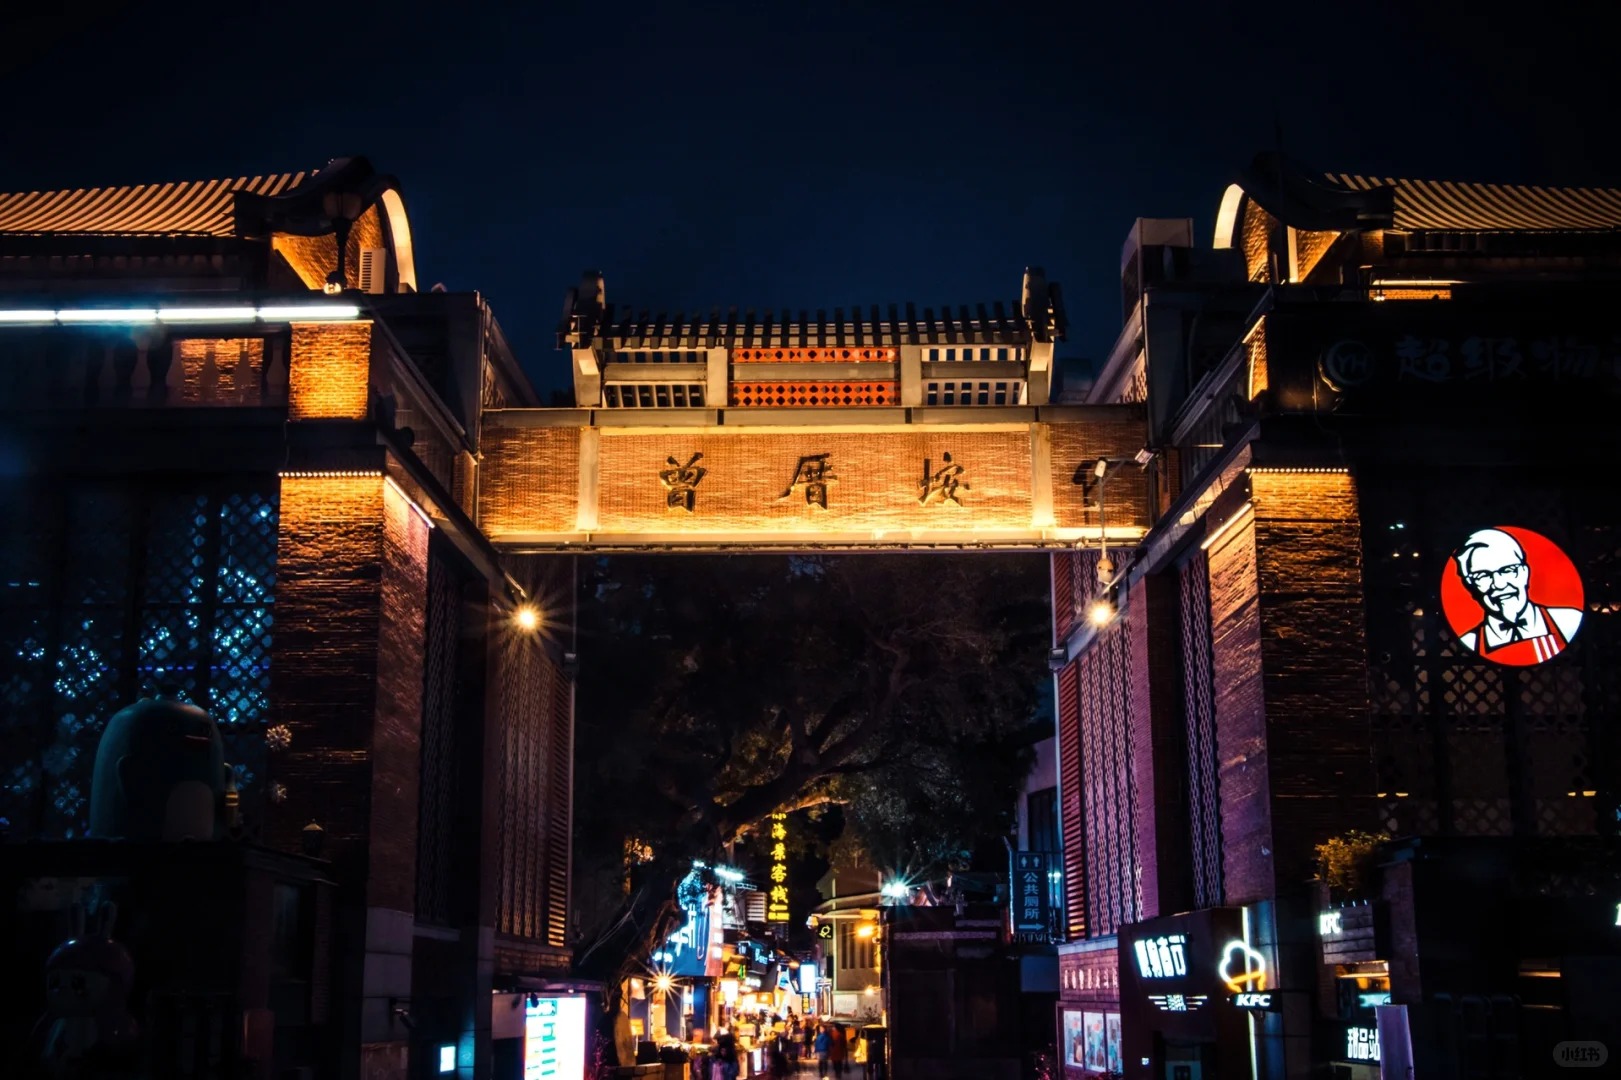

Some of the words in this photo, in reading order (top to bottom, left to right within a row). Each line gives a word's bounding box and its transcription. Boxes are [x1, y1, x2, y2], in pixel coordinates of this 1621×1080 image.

[659, 451, 970, 512] 曾厝垵
[1024, 872, 1040, 920] 公共厕所
[1235, 994, 1272, 1007] KFC
[1347, 1027, 1381, 1062] 甜品站
